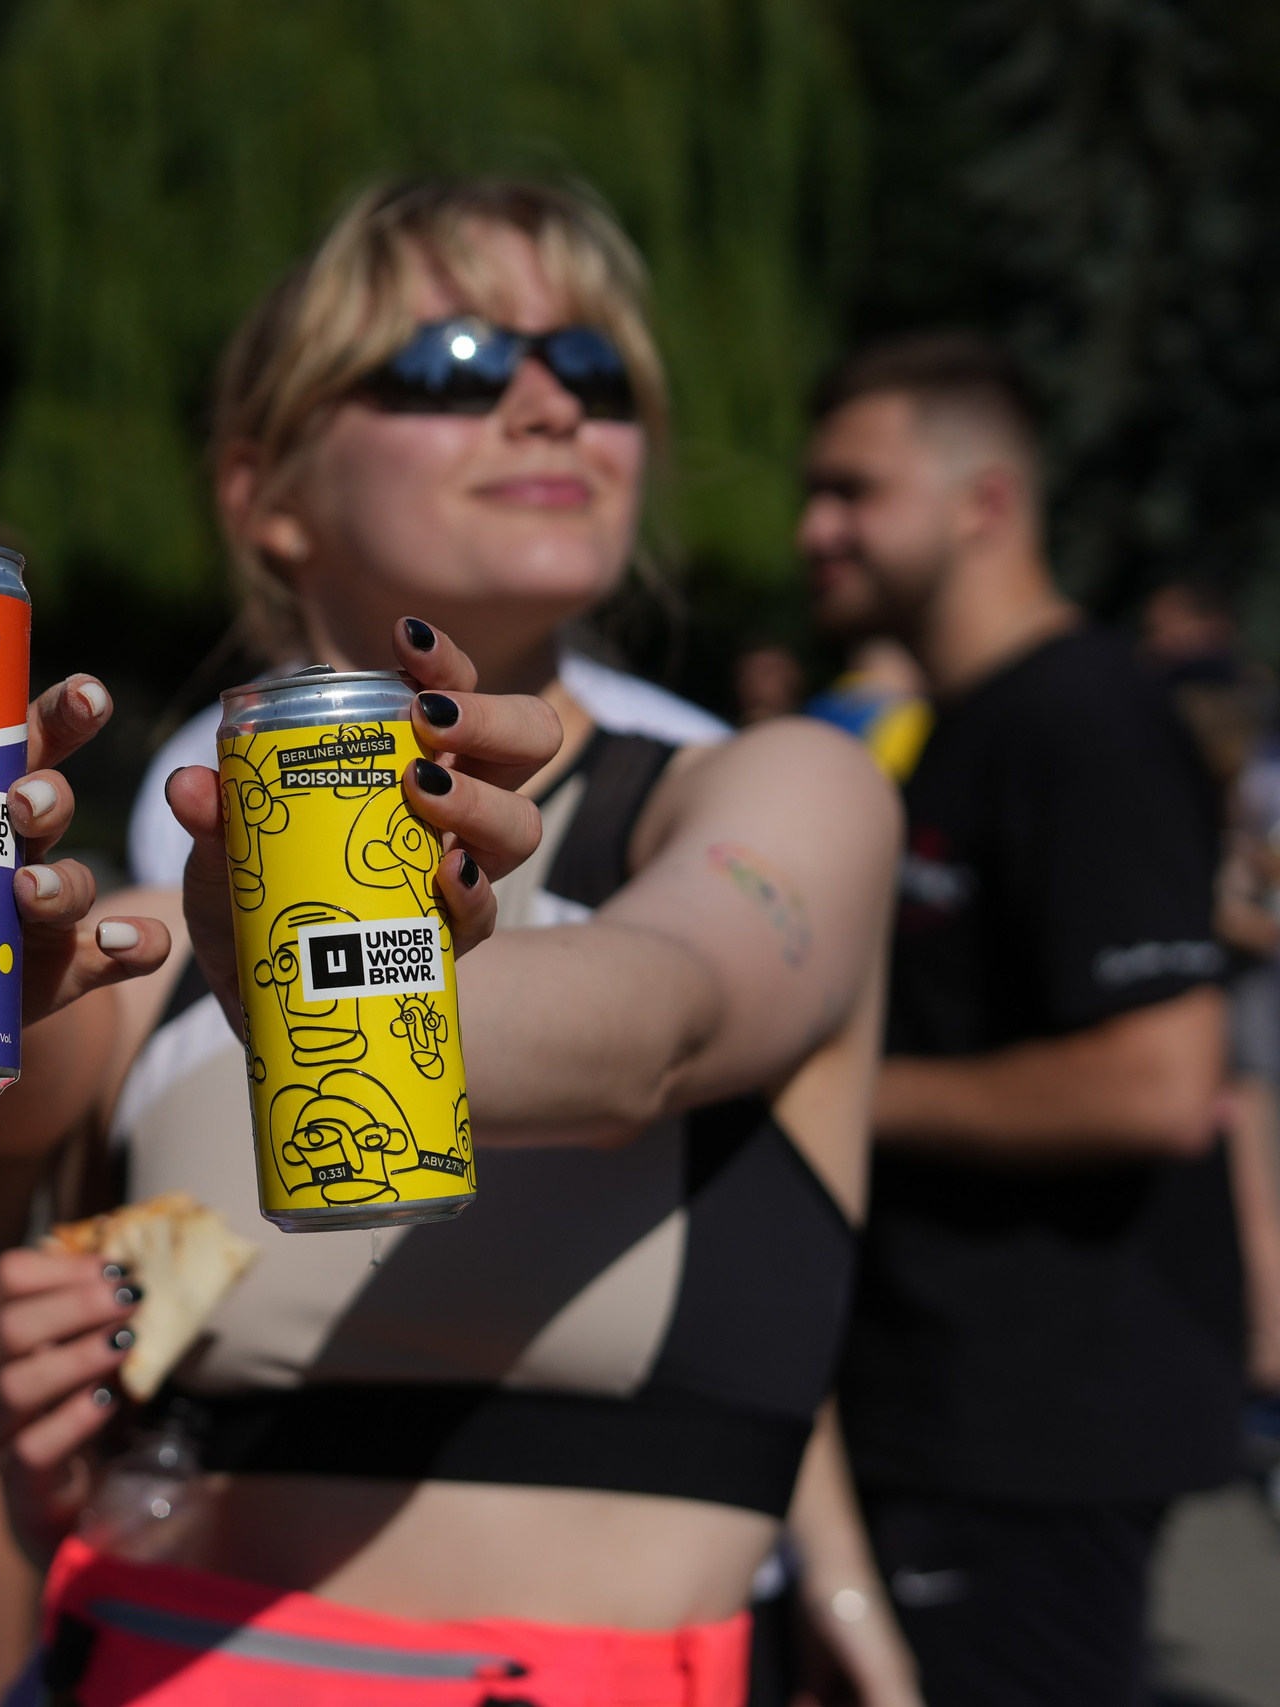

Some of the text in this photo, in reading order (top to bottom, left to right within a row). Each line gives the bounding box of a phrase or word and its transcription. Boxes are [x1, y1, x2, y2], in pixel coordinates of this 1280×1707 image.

[282, 740, 392, 763] BERLINER WEISSE
[286, 771, 392, 786] POISON LIPS
[365, 928, 433, 948] UNDER
[366, 946, 433, 966] WOOD
[369, 964, 435, 985] BRWR.
[422, 1156, 463, 1172] ABV 2.7%
